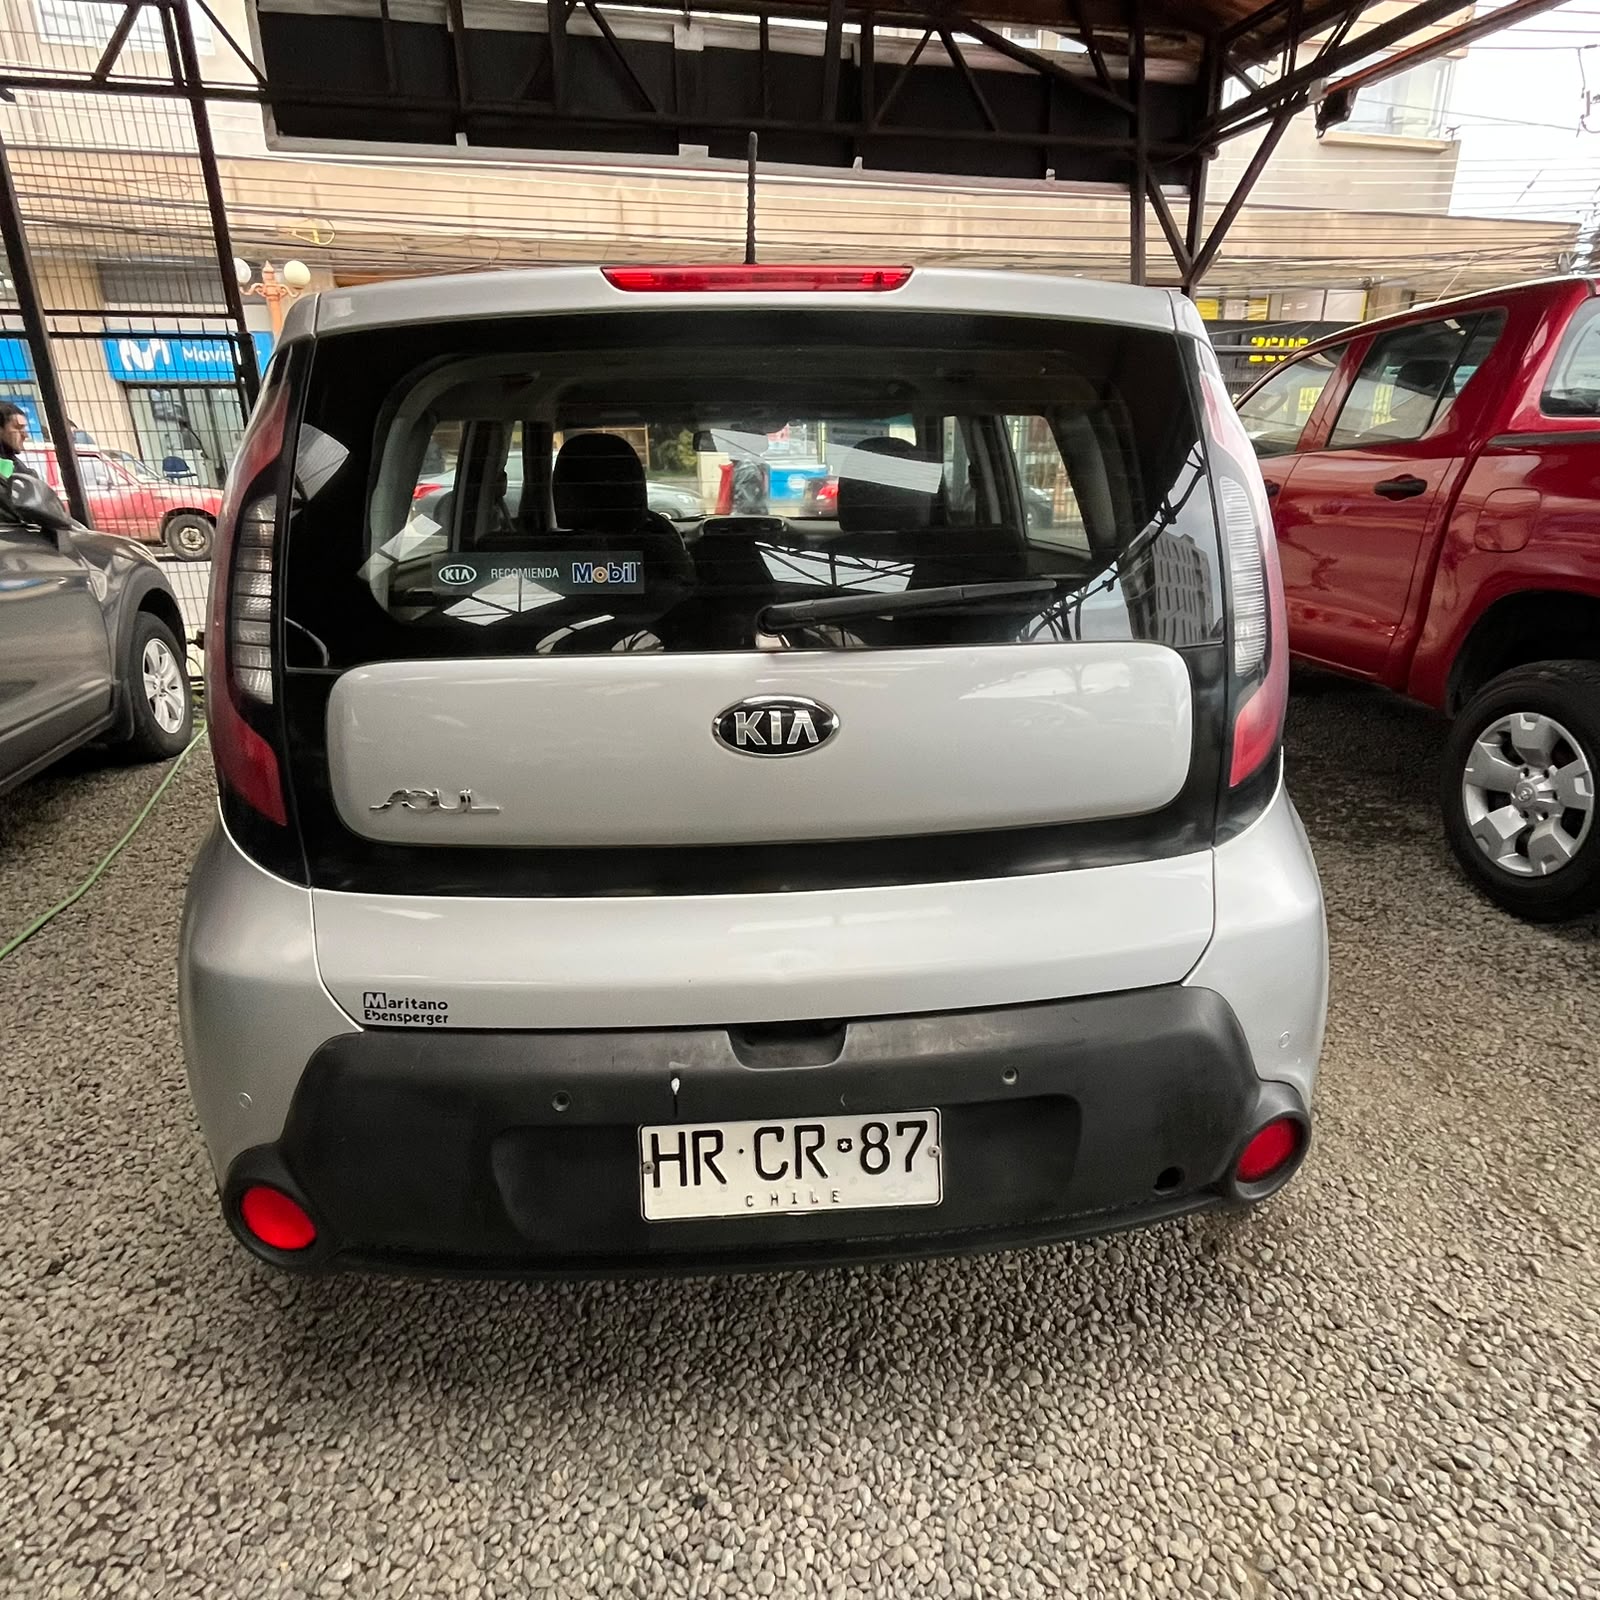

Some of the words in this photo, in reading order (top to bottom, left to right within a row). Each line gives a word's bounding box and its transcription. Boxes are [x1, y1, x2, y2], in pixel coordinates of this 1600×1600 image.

[491, 568, 560, 579] RECOMIENDA
[572, 562, 637, 583] Mobil
[734, 710, 820, 745] KIA
[363, 992, 448, 1010] Maritano
[364, 1009, 449, 1025] Ebensperger
[745, 1190, 842, 1207] CHILE
